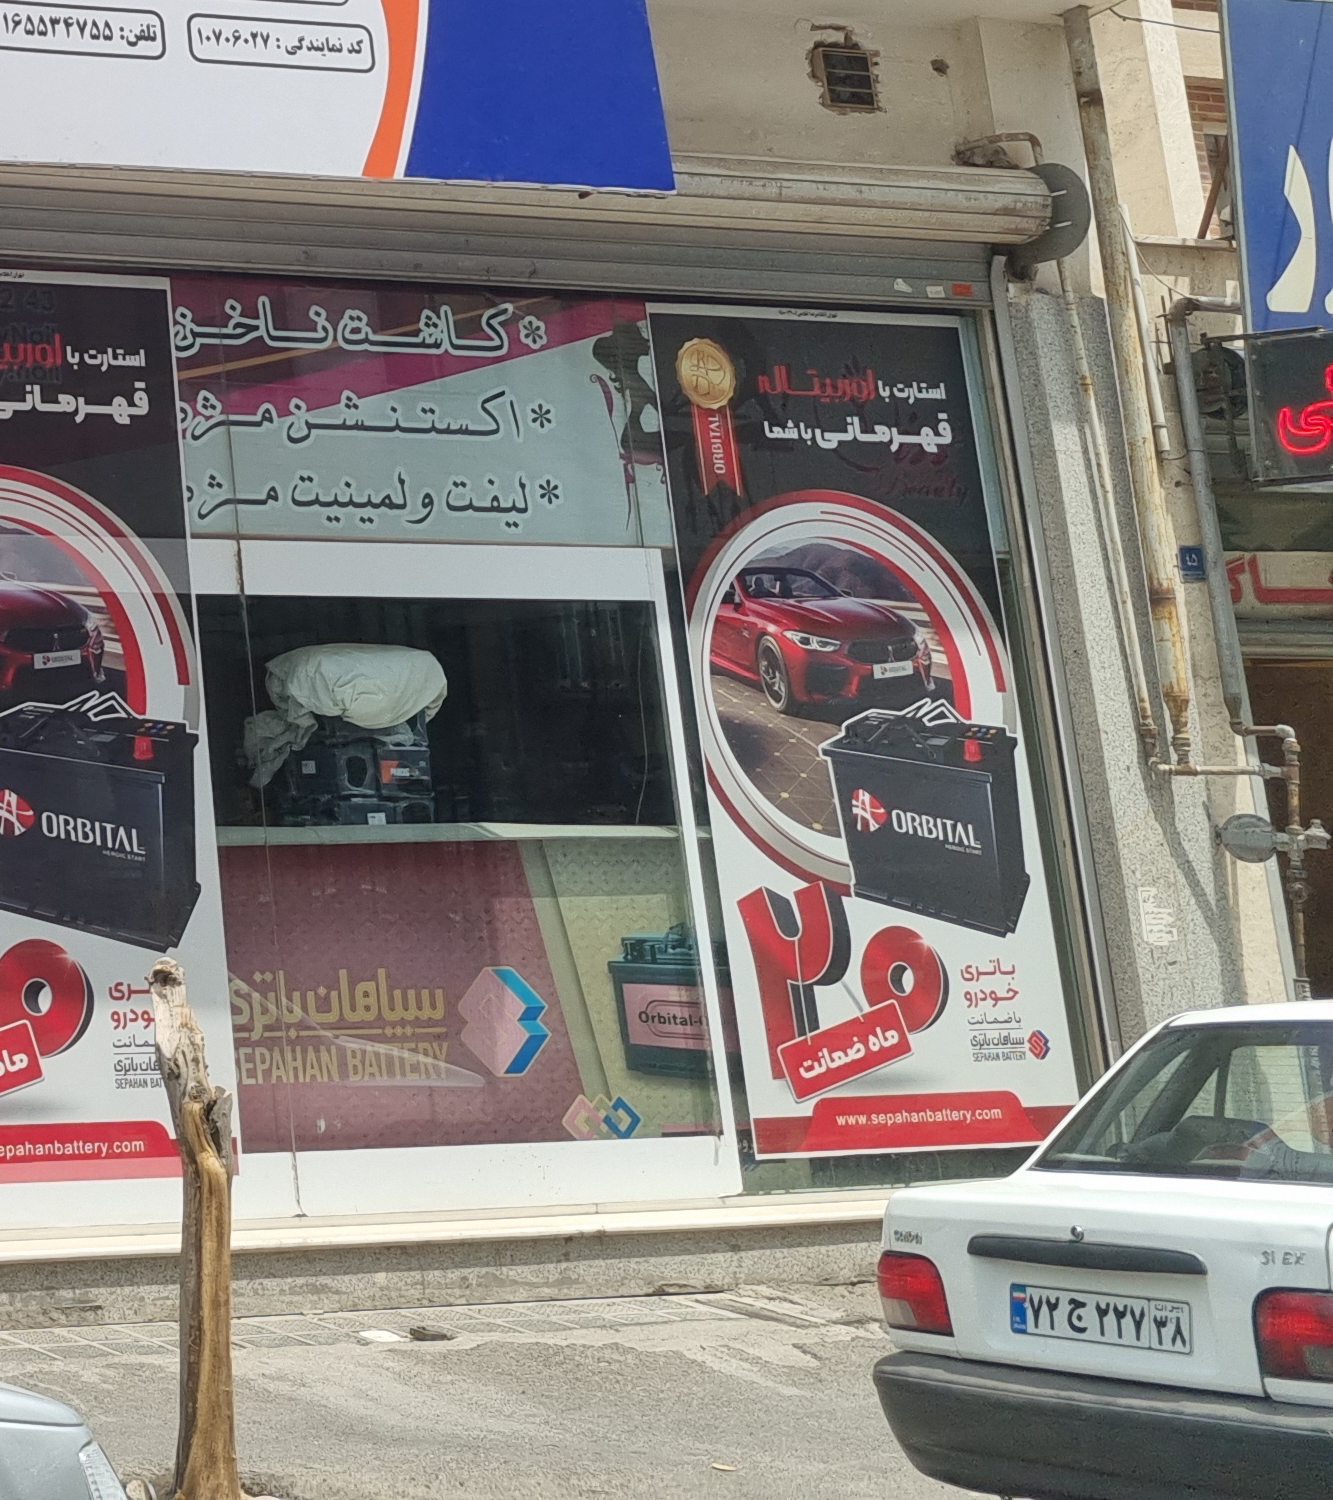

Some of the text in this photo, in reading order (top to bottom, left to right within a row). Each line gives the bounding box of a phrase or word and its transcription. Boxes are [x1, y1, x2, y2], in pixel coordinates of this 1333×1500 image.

[197, 26, 364, 58] کد نمایندگی ۱۰۷۰۶۰۲۷
[174, 296, 513, 356] کاشت ناخن
[66, 346, 80, 371] با
[84, 348, 146, 372] استارت
[878, 379, 890, 403] با
[892, 381, 946, 404] استارت
[287, 390, 521, 445] اکستنشن
[763, 412, 953, 453] قهرمانی با شما
[707, 413, 726, 475] ORBITAL
[292, 471, 407, 527] لمینیت
[405, 488, 434, 524] و
[447, 475, 529, 531] لیفت
[41, 810, 146, 855] ORBITAL
[892, 809, 983, 849] ORBITAL
[960, 958, 1017, 983] باتری
[306, 968, 446, 1039] سپاهان
[963, 983, 1021, 1009] خودرو
[346, 1042, 450, 1082] BATTERY
[798, 1026, 900, 1080] ماه ضمانت
[836, 1106, 1002, 1128] www.sepahanbattery.com
[1067, 1297, 1089, 1334] ج
[1152, 1314, 1187, 1348] ۳۸
